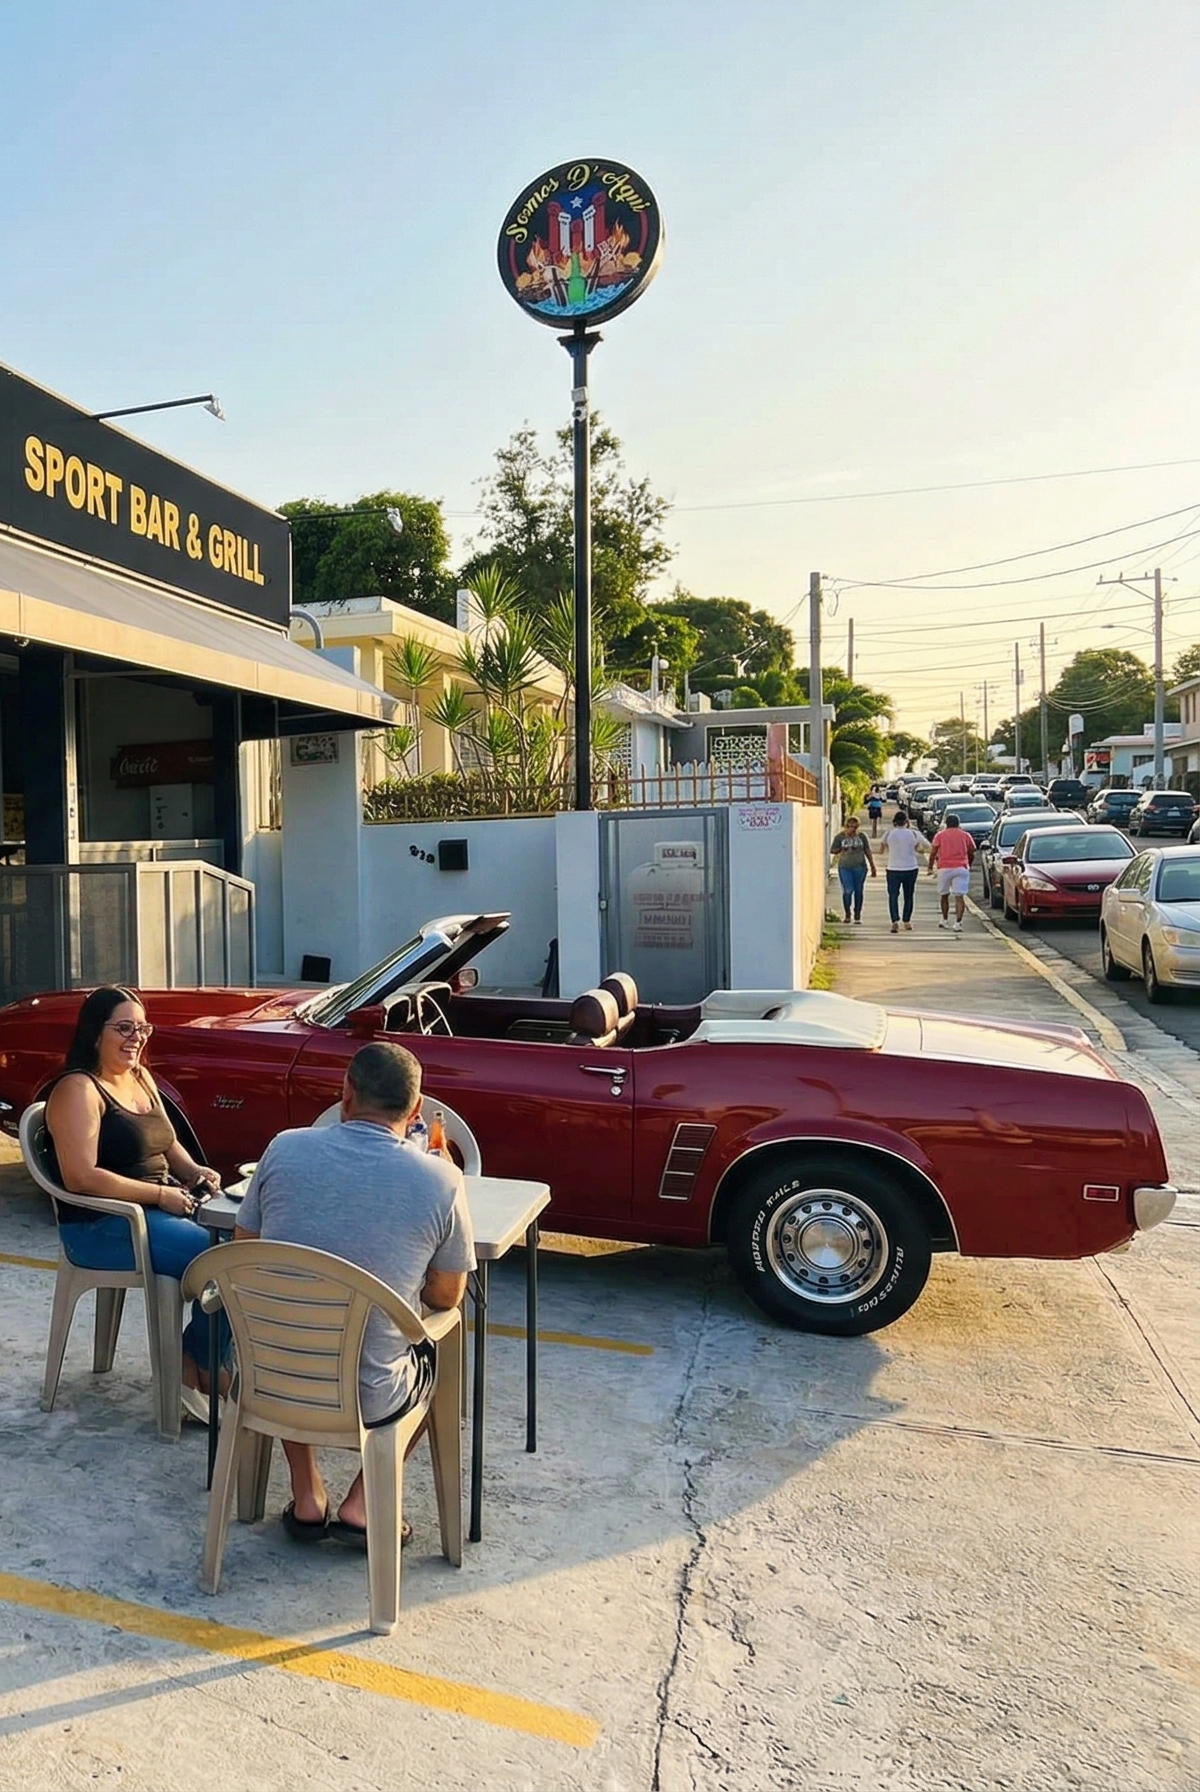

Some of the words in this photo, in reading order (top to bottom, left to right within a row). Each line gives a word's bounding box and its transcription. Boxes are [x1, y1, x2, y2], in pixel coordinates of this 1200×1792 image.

[506, 176, 559, 244] Somos
[24, 436, 123, 525] SPORT
[130, 484, 181, 551] BAR
[187, 512, 203, 561] &
[208, 524, 264, 586] GRILL
